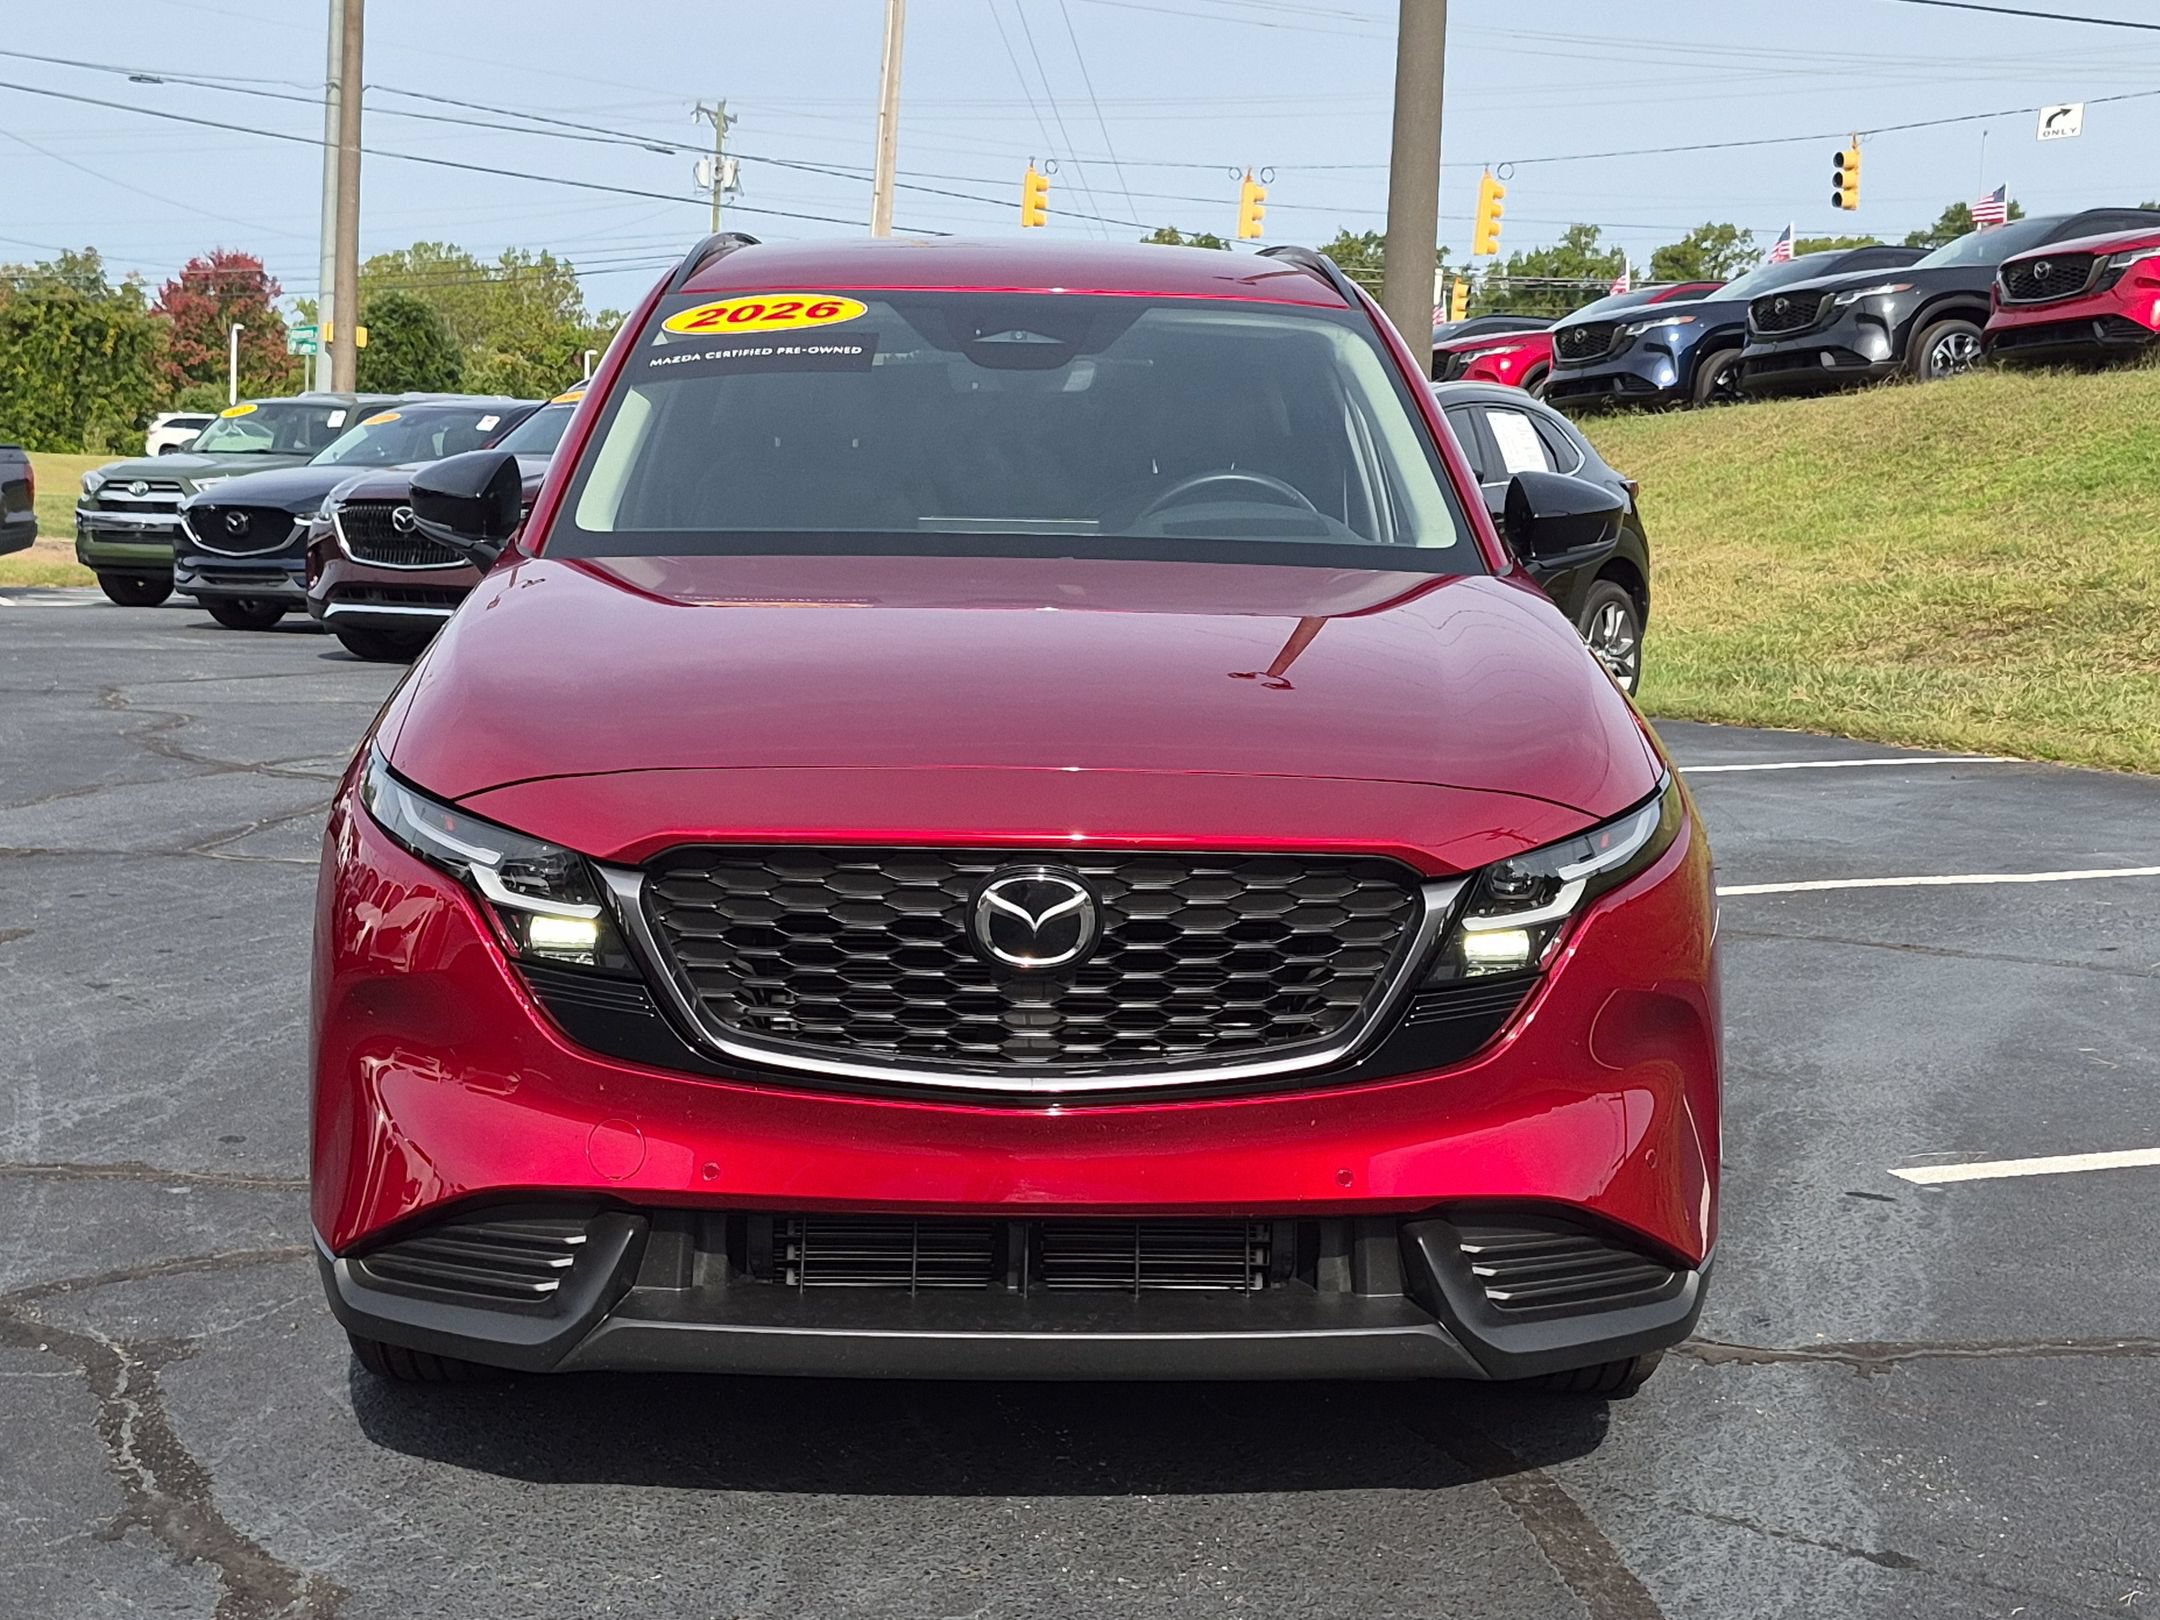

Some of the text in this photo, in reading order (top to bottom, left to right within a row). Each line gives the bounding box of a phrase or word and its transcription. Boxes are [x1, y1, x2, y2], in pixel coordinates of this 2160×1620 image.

[2042, 127, 2078, 137] ONLY
[684, 302, 846, 329] 2026
[649, 346, 862, 367] MAZDA CERTIFIED PRE-OWNED
